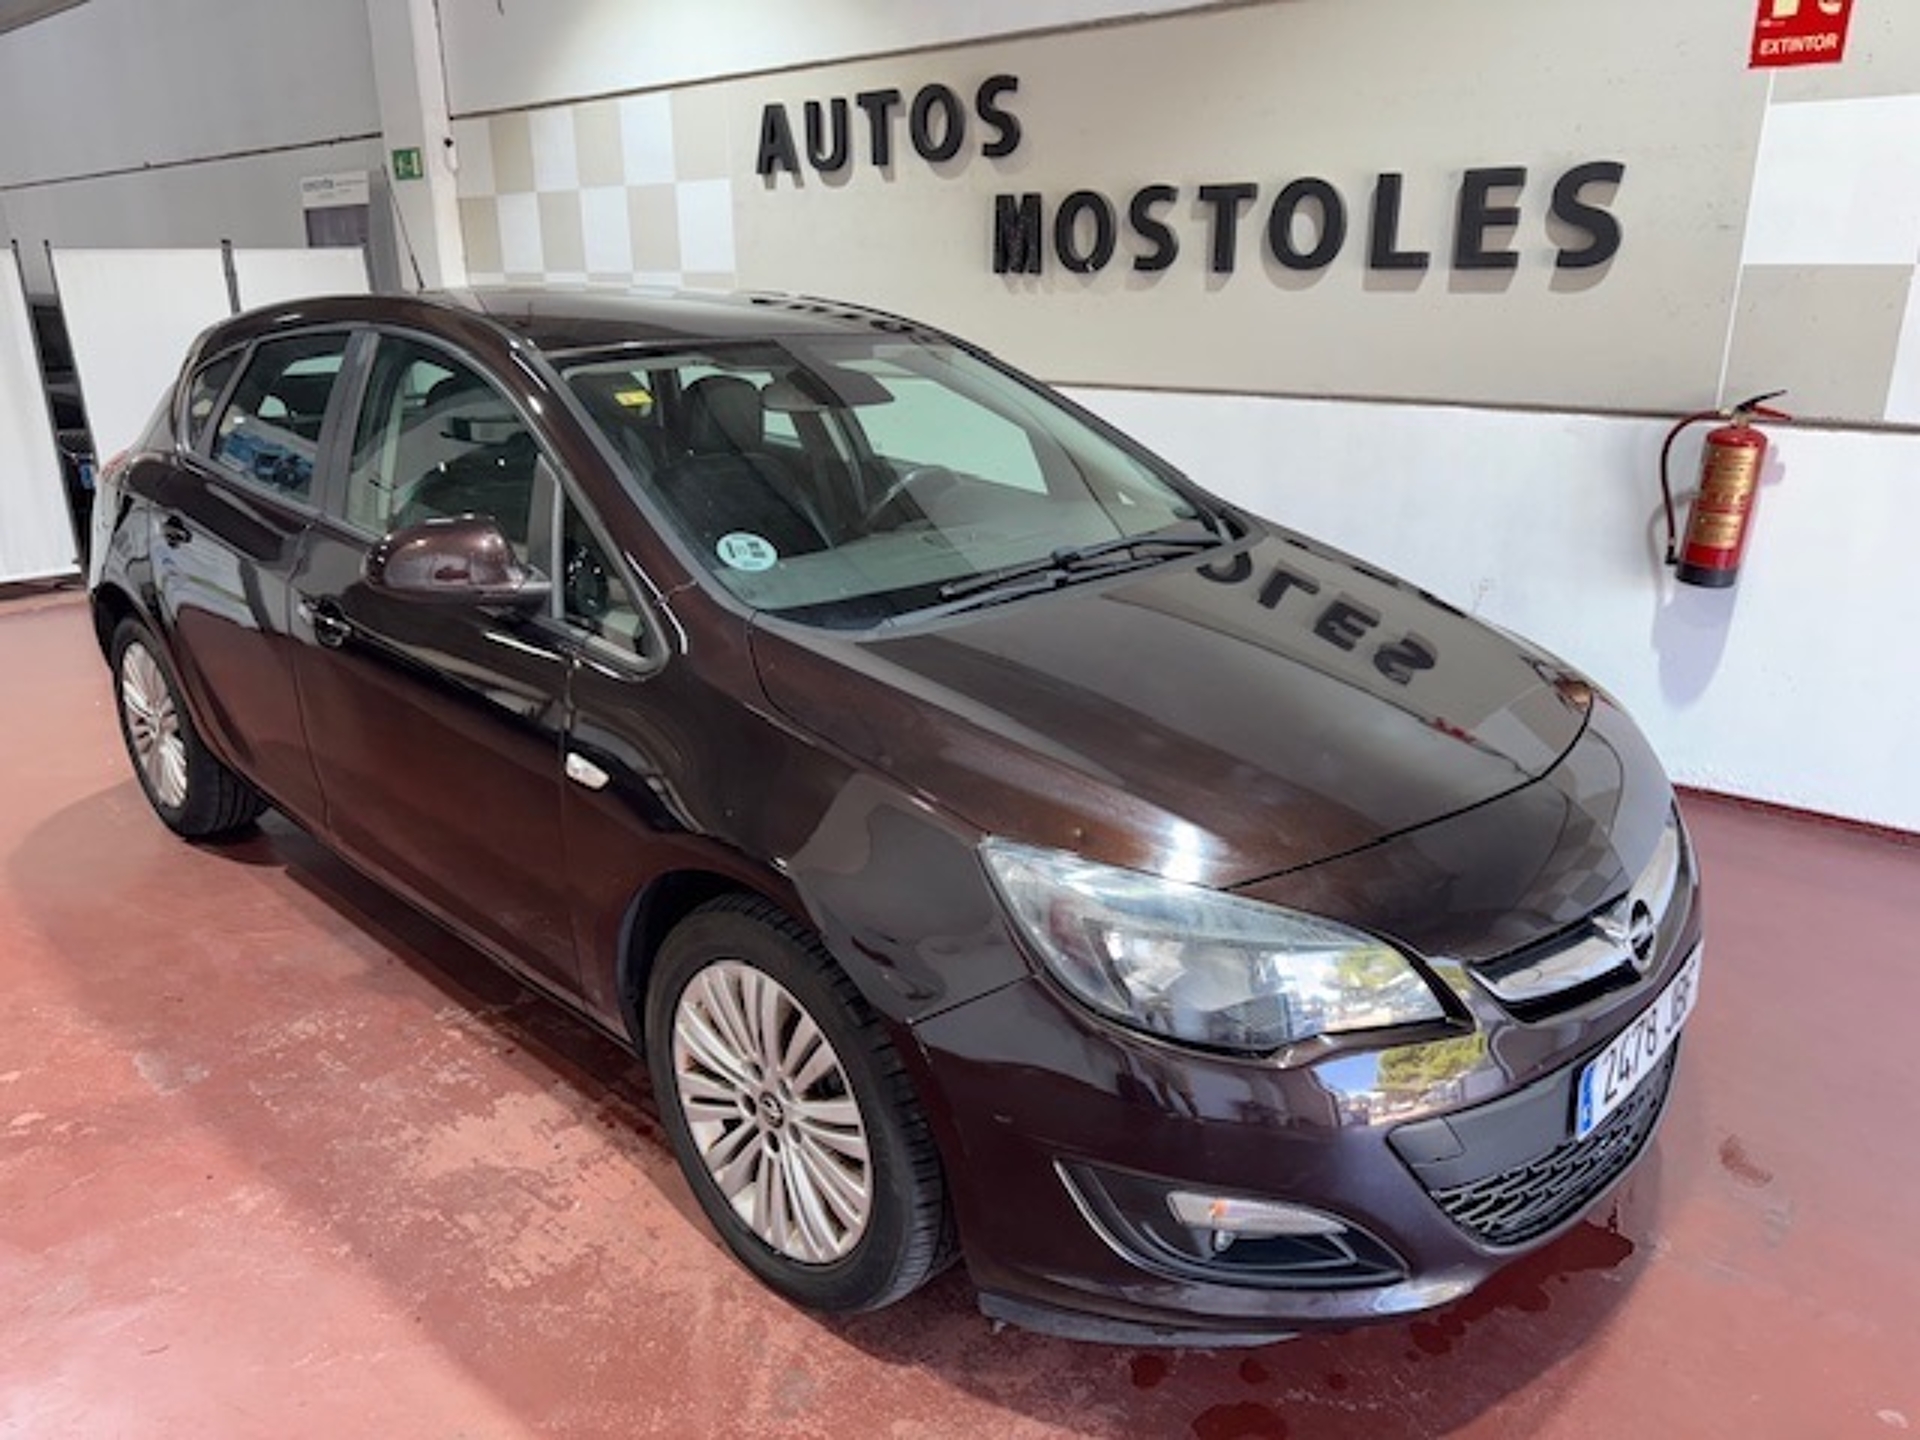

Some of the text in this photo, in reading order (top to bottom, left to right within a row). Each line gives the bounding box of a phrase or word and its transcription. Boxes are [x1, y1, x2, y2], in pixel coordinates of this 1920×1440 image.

[1759, 33, 1839, 56] EXTINTOR
[756, 74, 1022, 174] AUTOS
[992, 161, 1626, 275] MOSTOLES
[1602, 1006, 1658, 1105] 2478
